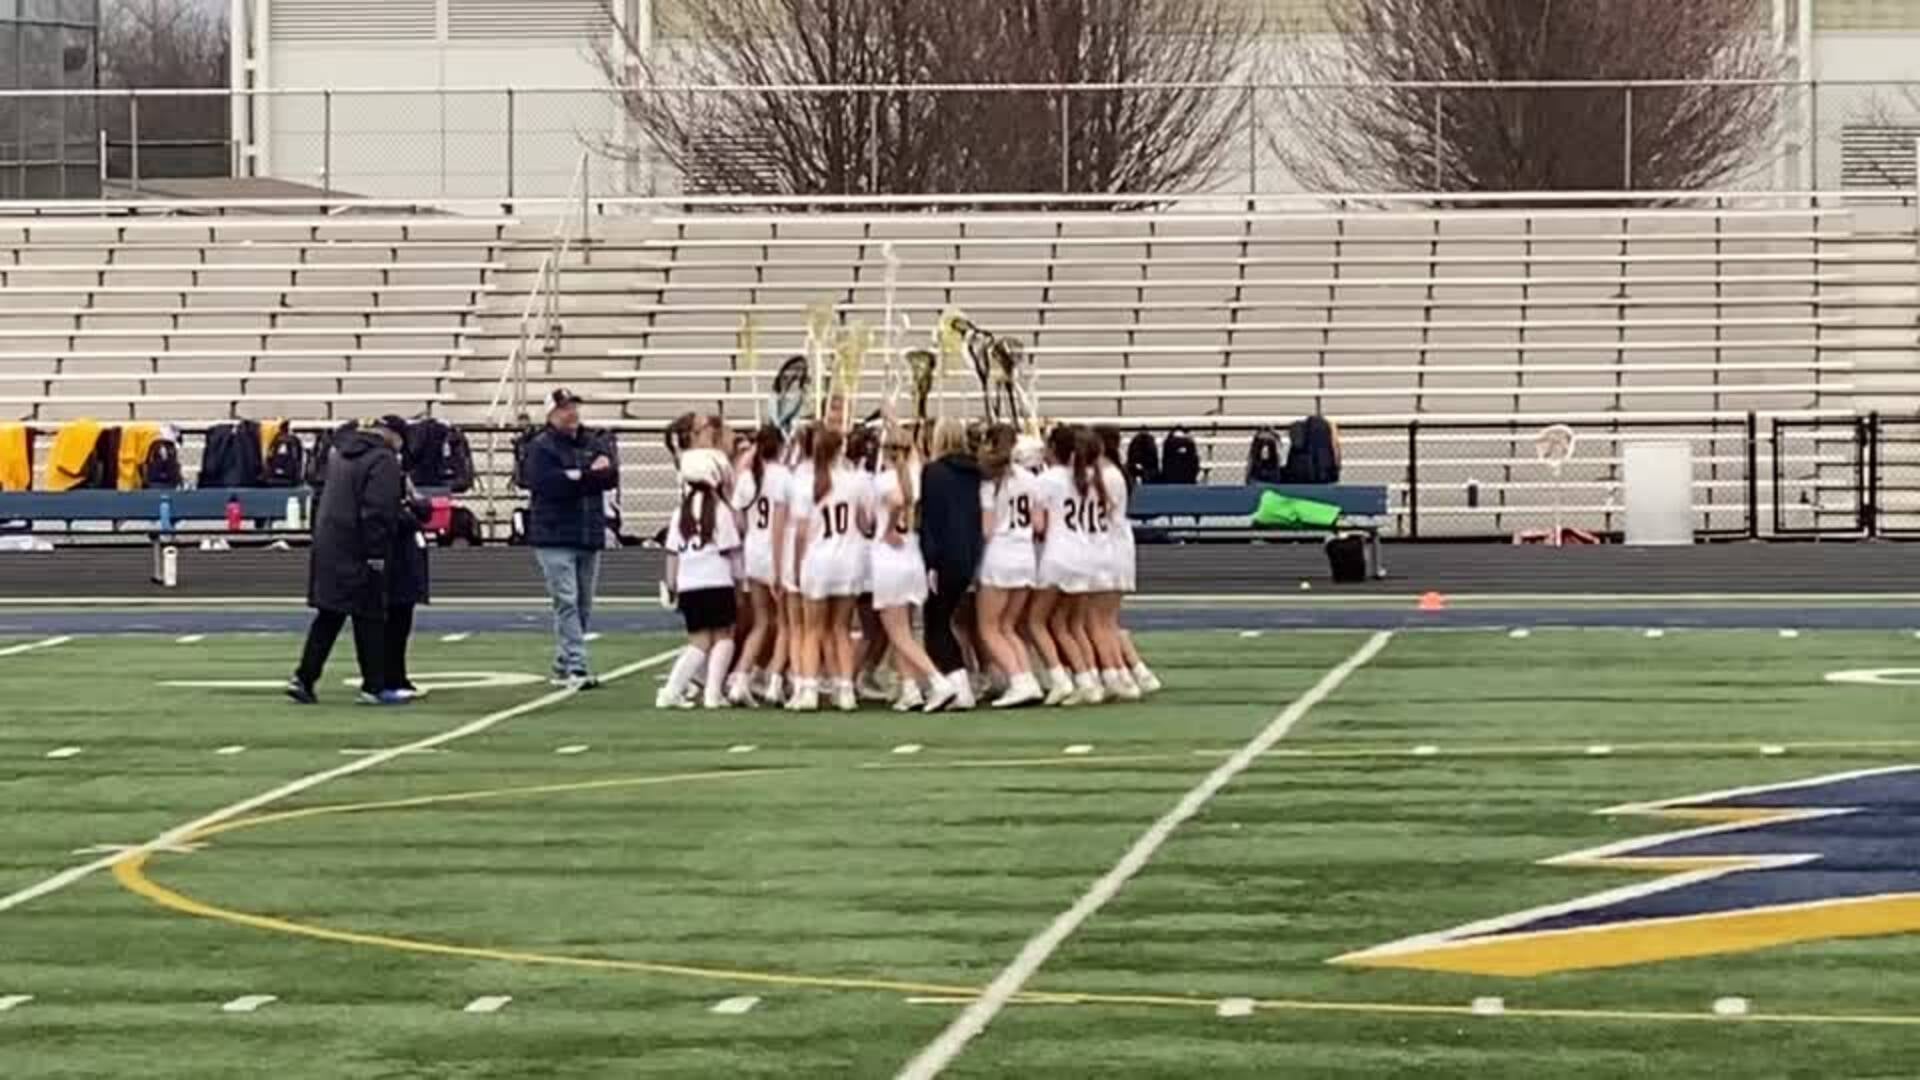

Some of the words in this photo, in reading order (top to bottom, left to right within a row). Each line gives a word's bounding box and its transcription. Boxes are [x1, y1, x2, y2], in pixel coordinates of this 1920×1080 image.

[757, 496, 770, 530] 9
[822, 501, 849, 539] 10
[1008, 494, 1031, 529] 19
